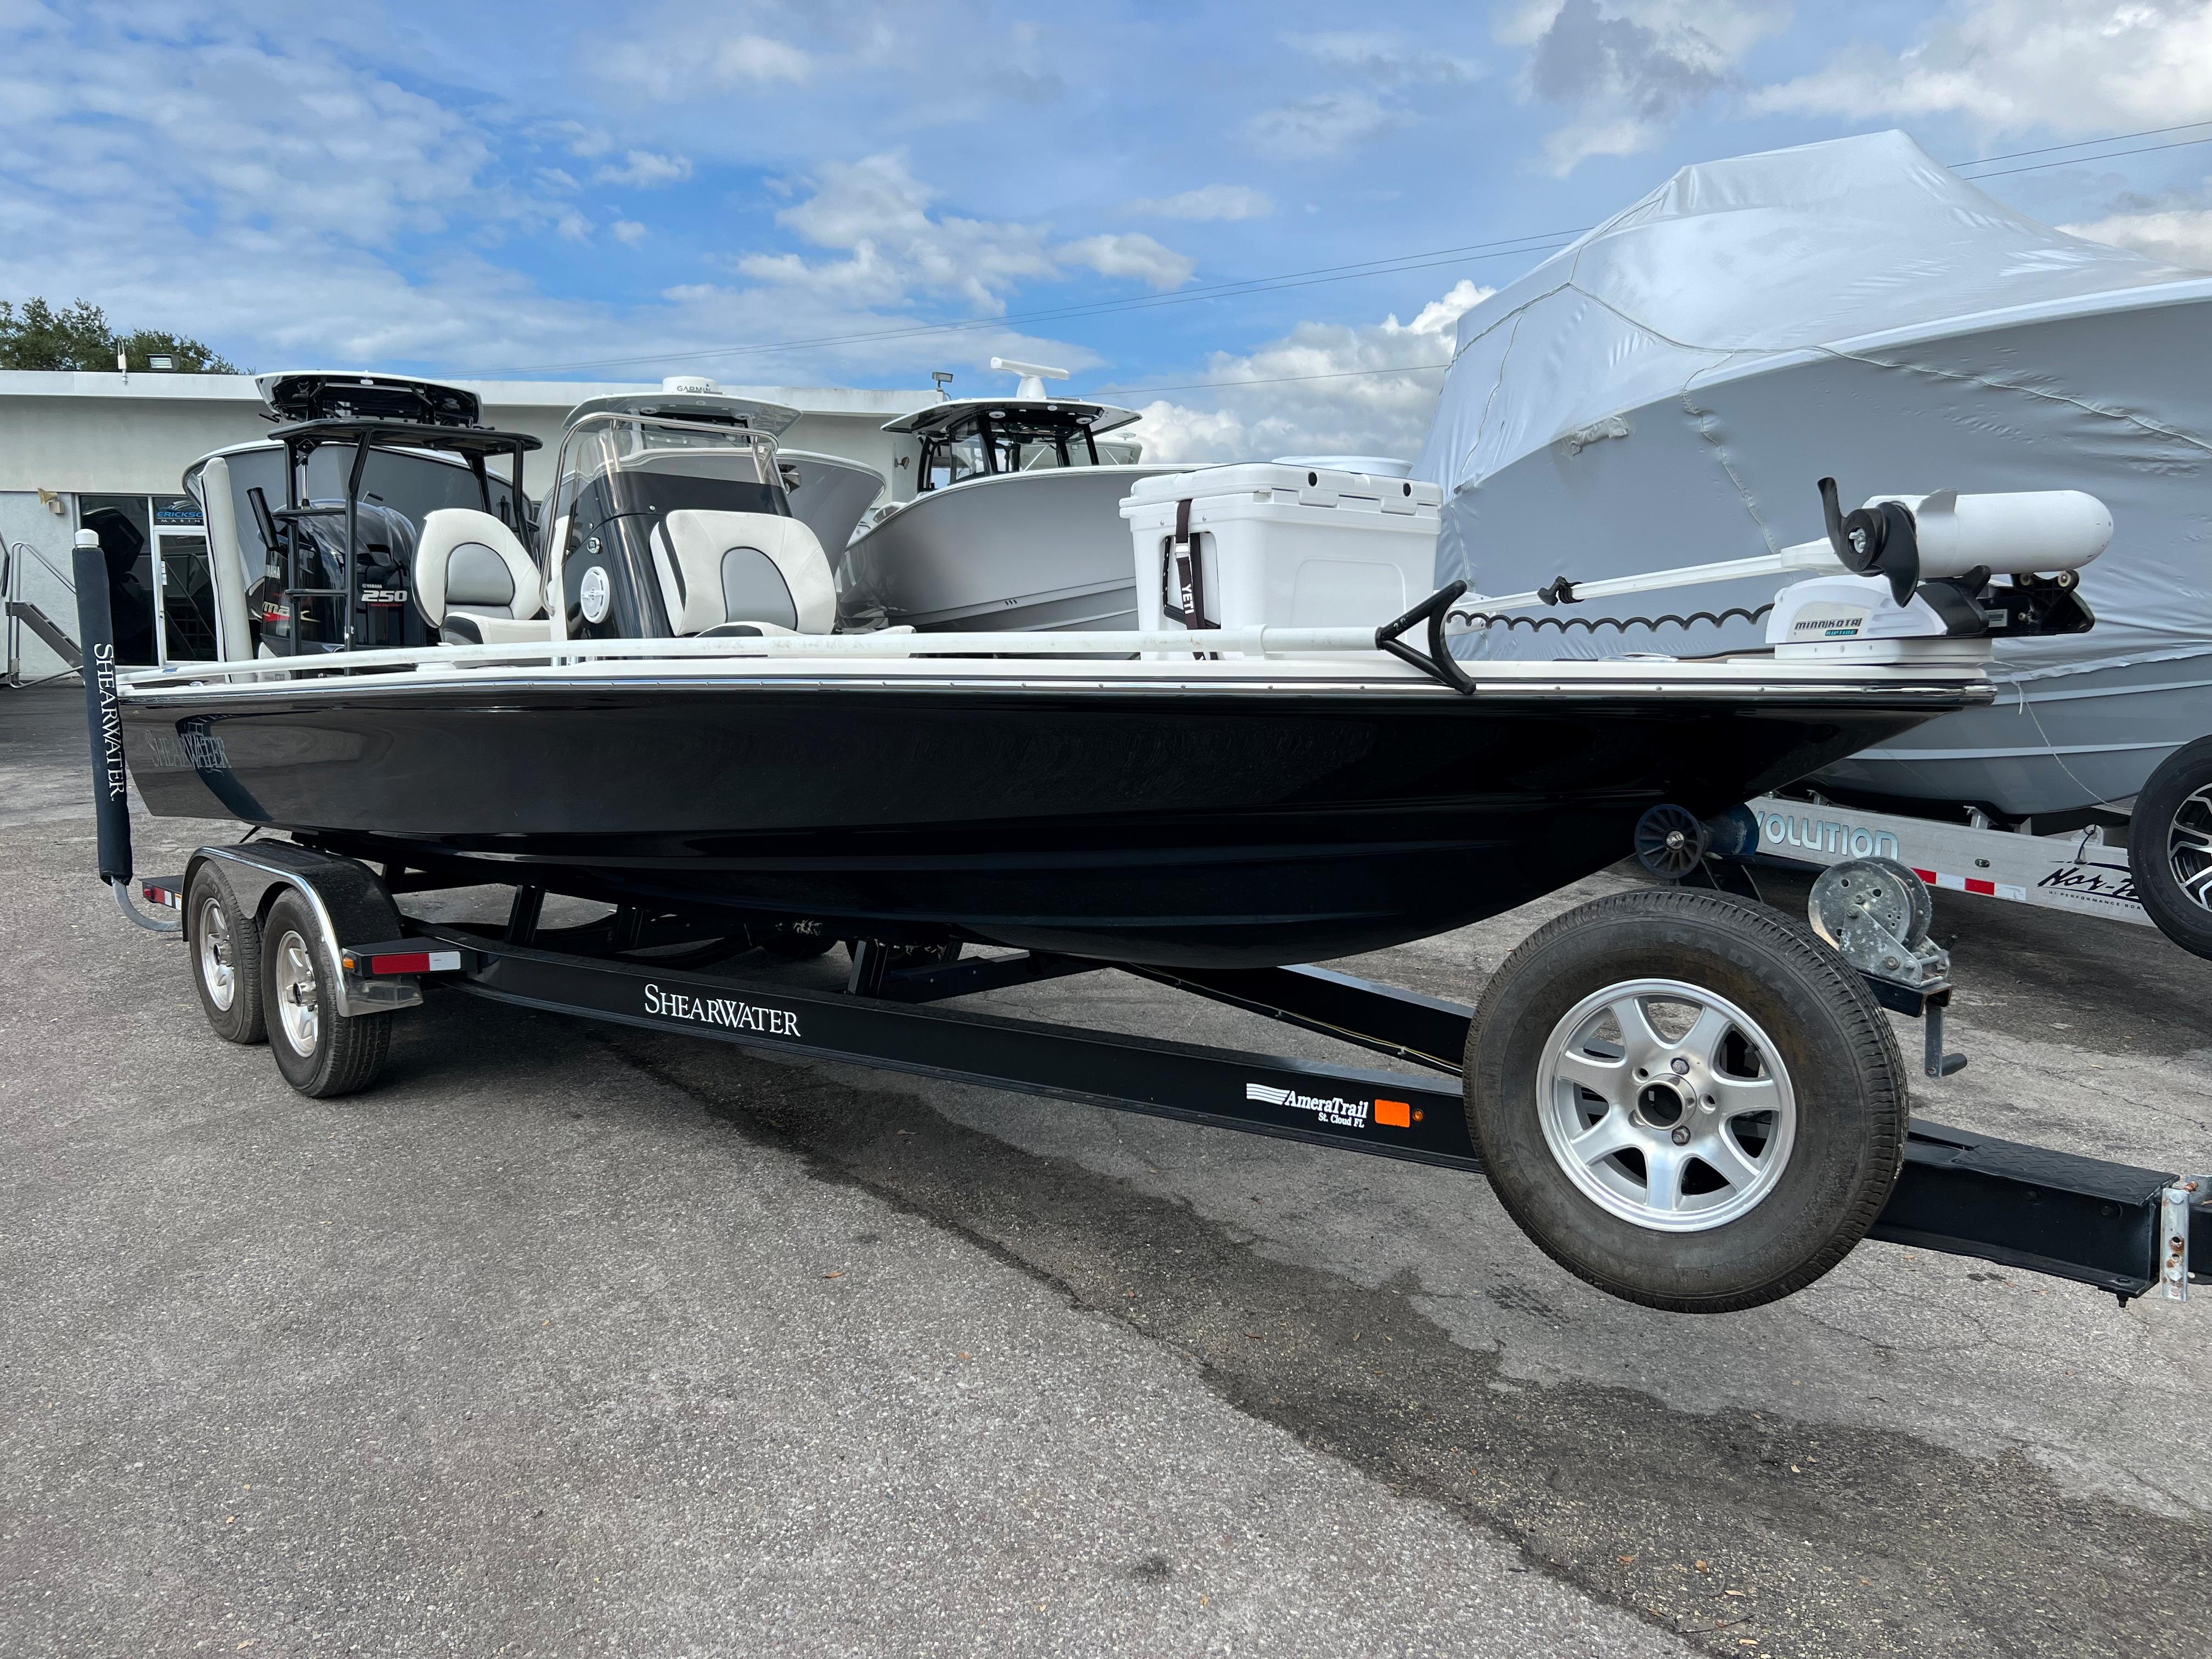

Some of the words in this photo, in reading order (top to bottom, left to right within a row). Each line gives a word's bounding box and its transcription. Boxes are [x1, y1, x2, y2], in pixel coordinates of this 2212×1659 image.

[361, 590, 408, 602] 250
[1182, 583, 1194, 614] YETI
[1795, 620, 1826, 630] MINN
[1827, 619, 1861, 628] KOTA
[2060, 892, 2120, 906] PERFORMANCE
[1284, 1090, 1369, 1119] AmeraTrail
[1318, 1113, 1329, 1122] St.
[1331, 1114, 1352, 1126] Cloud
[1354, 1119, 1364, 1128] FL
